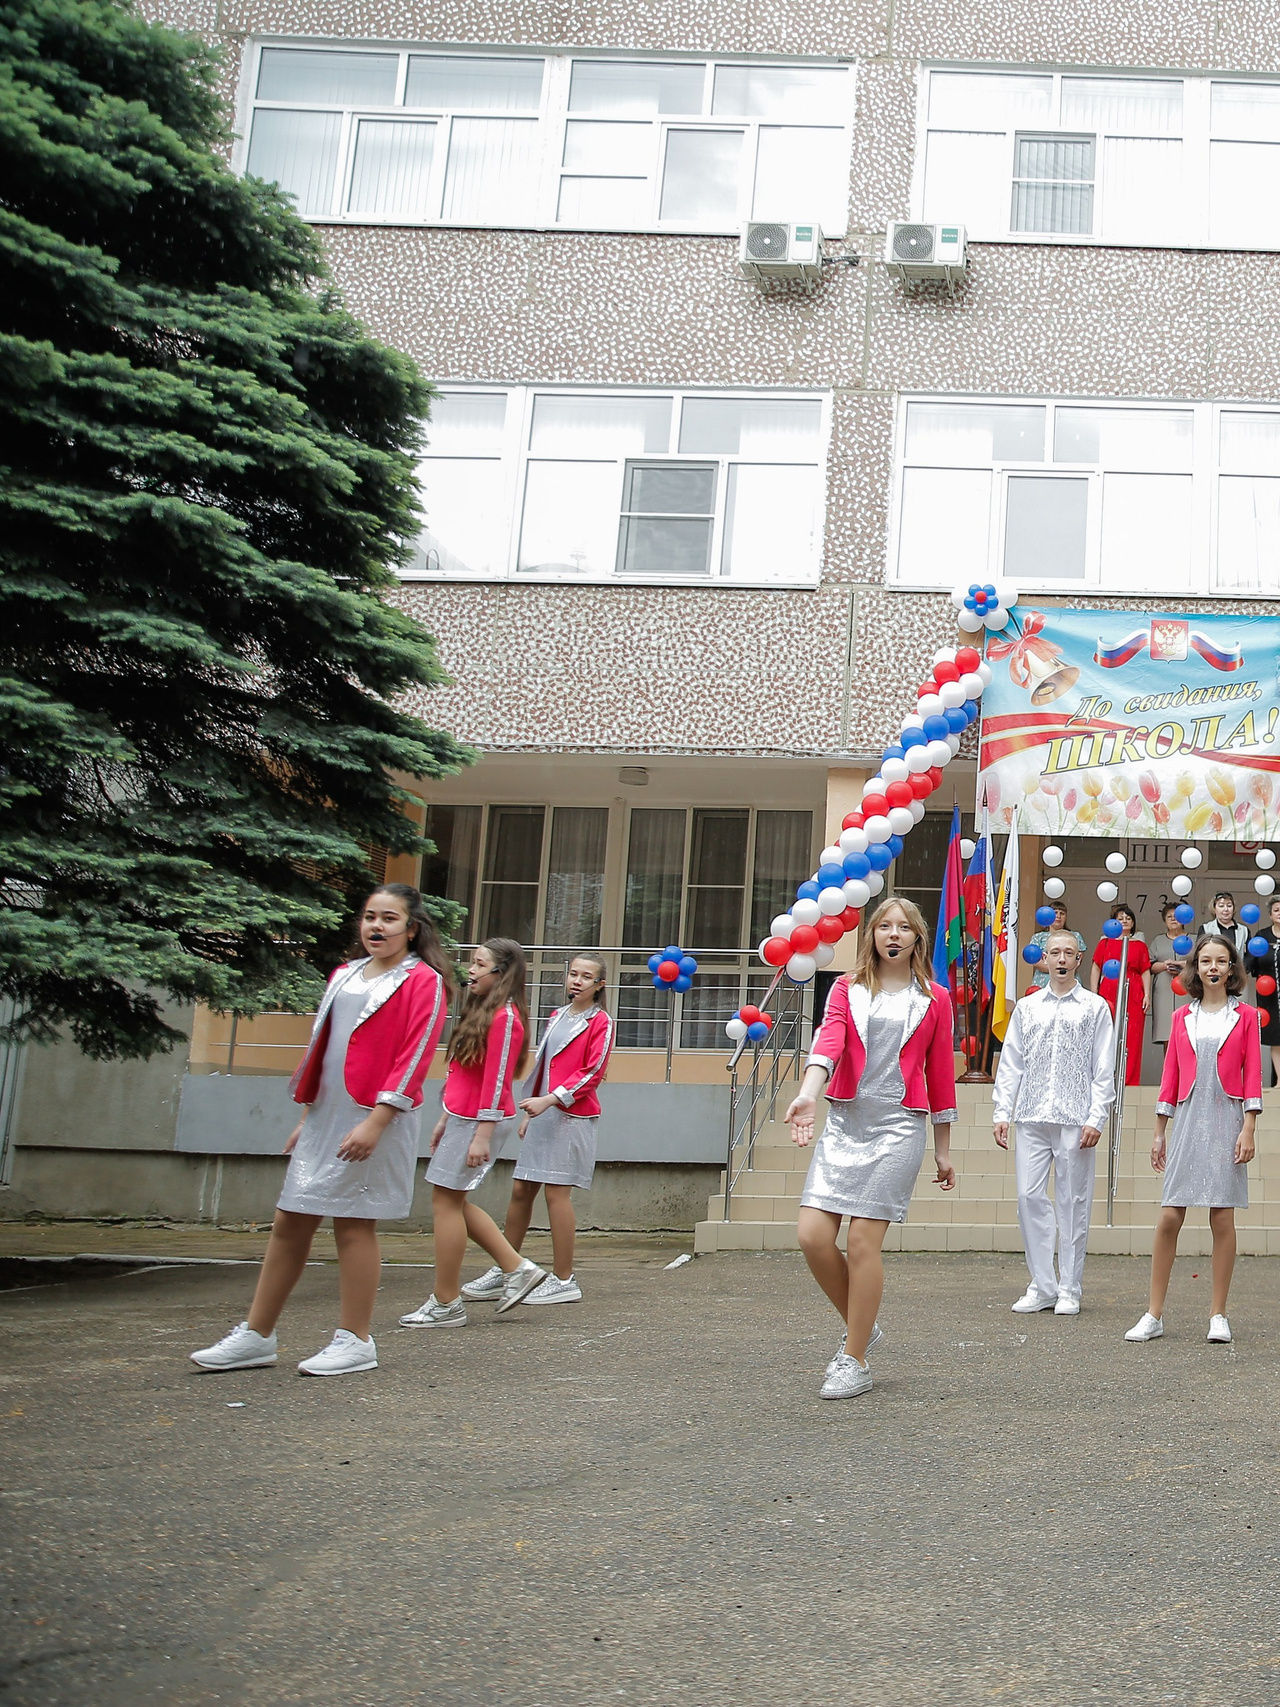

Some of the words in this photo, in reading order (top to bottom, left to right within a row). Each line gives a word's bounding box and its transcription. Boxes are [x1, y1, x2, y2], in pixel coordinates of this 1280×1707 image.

[1065, 695, 1112, 727] До
[1124, 681, 1263, 714] свидания,
[1040, 707, 1280, 775] ШКОЛА!
